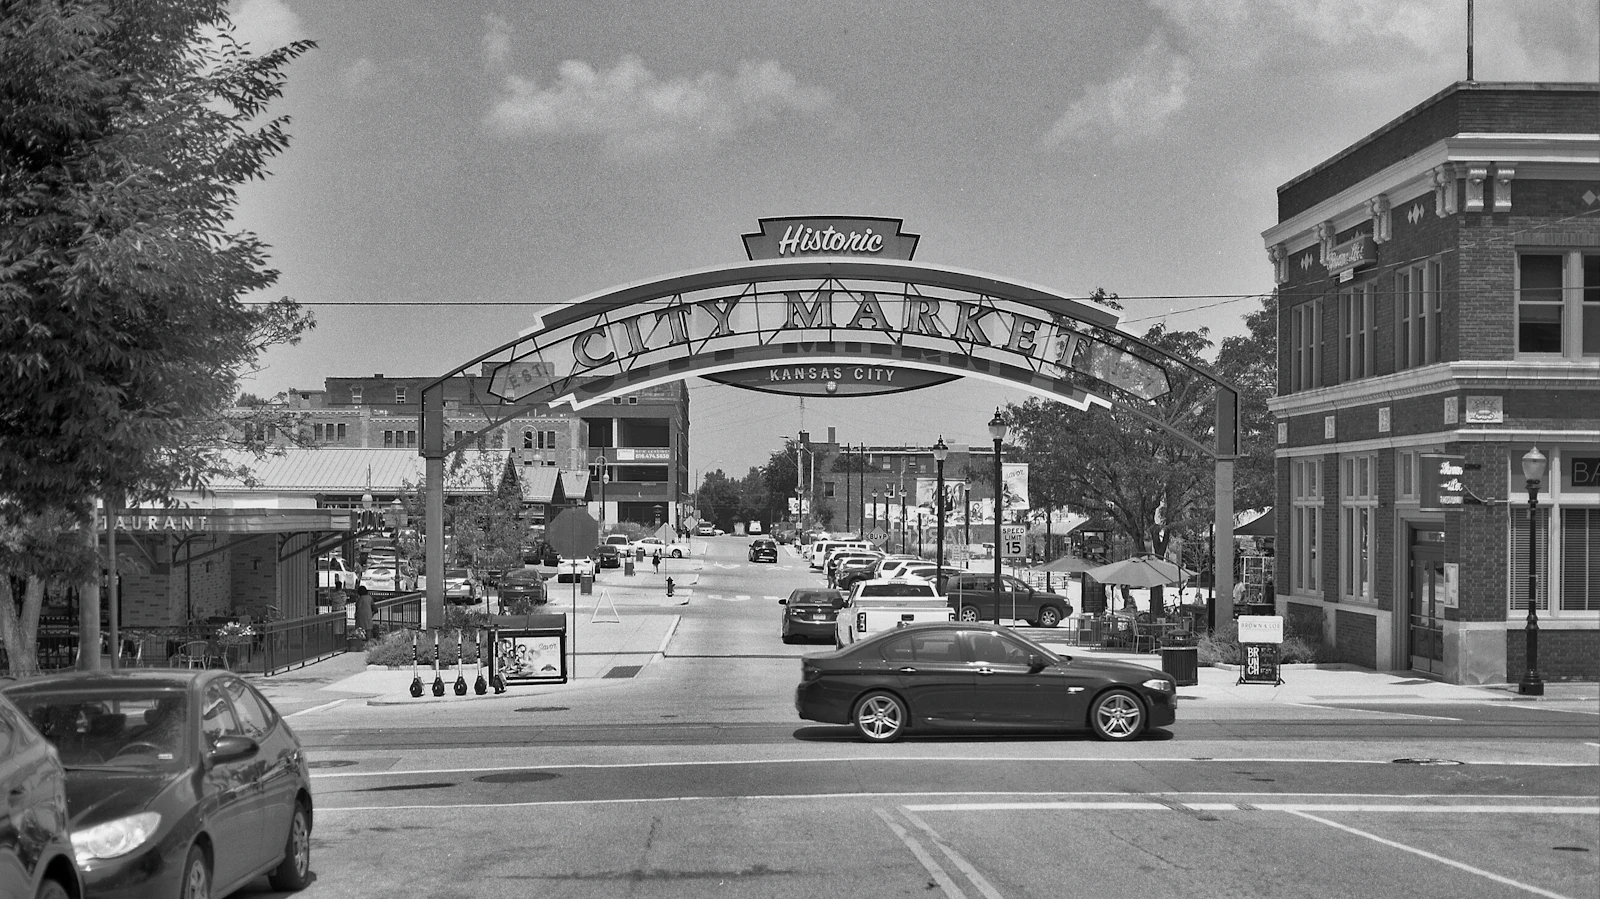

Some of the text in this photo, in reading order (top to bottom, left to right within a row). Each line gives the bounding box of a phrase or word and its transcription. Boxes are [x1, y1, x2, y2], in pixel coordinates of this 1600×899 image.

[779, 223, 883, 255] Historic
[572, 290, 1094, 369] CITY MARKET
[770, 367, 895, 382] KANSAS CITY
[1005, 542, 1021, 554] 15
